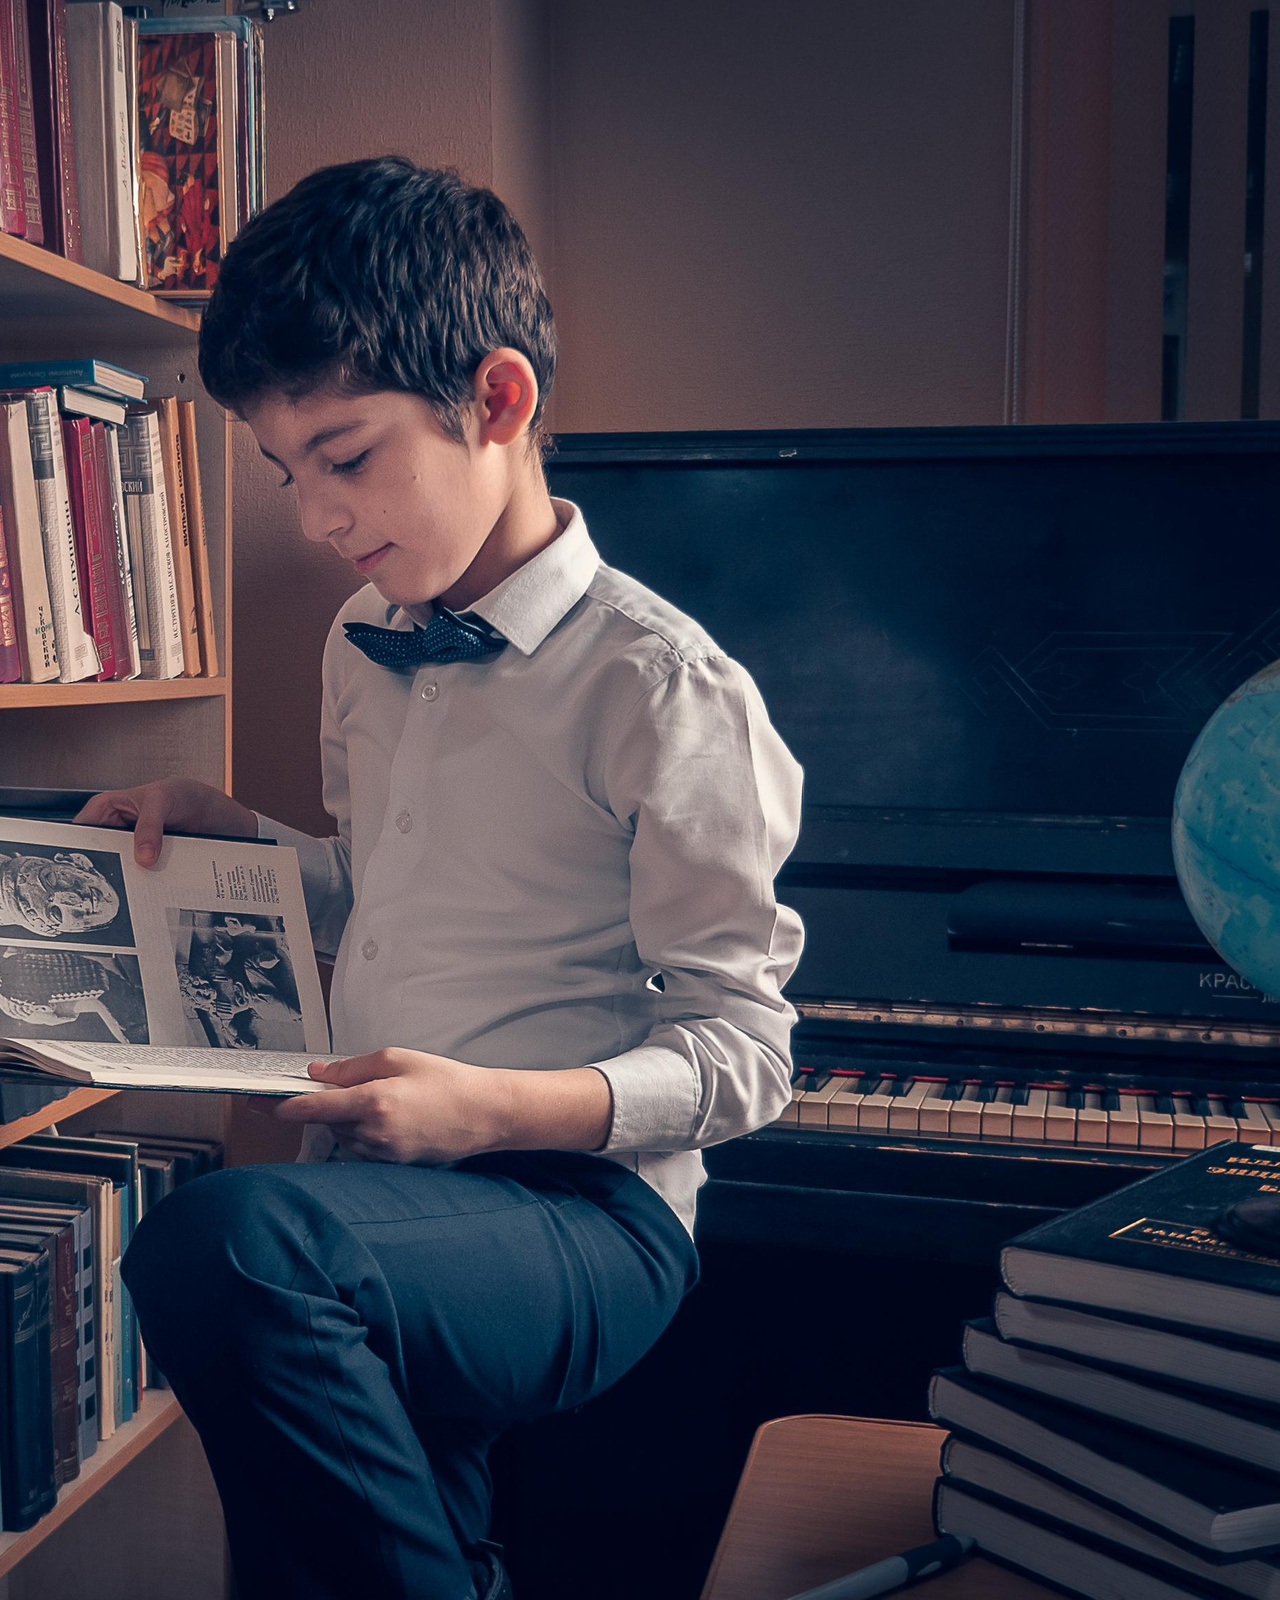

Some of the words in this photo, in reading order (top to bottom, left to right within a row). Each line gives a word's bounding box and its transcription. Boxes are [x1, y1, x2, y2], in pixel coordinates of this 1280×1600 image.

[174, 433, 184, 488] КОЗЛОВ
[180, 493, 189, 548] ВИЛЬЯМ
[1199, 972, 1257, 990] КРАС
